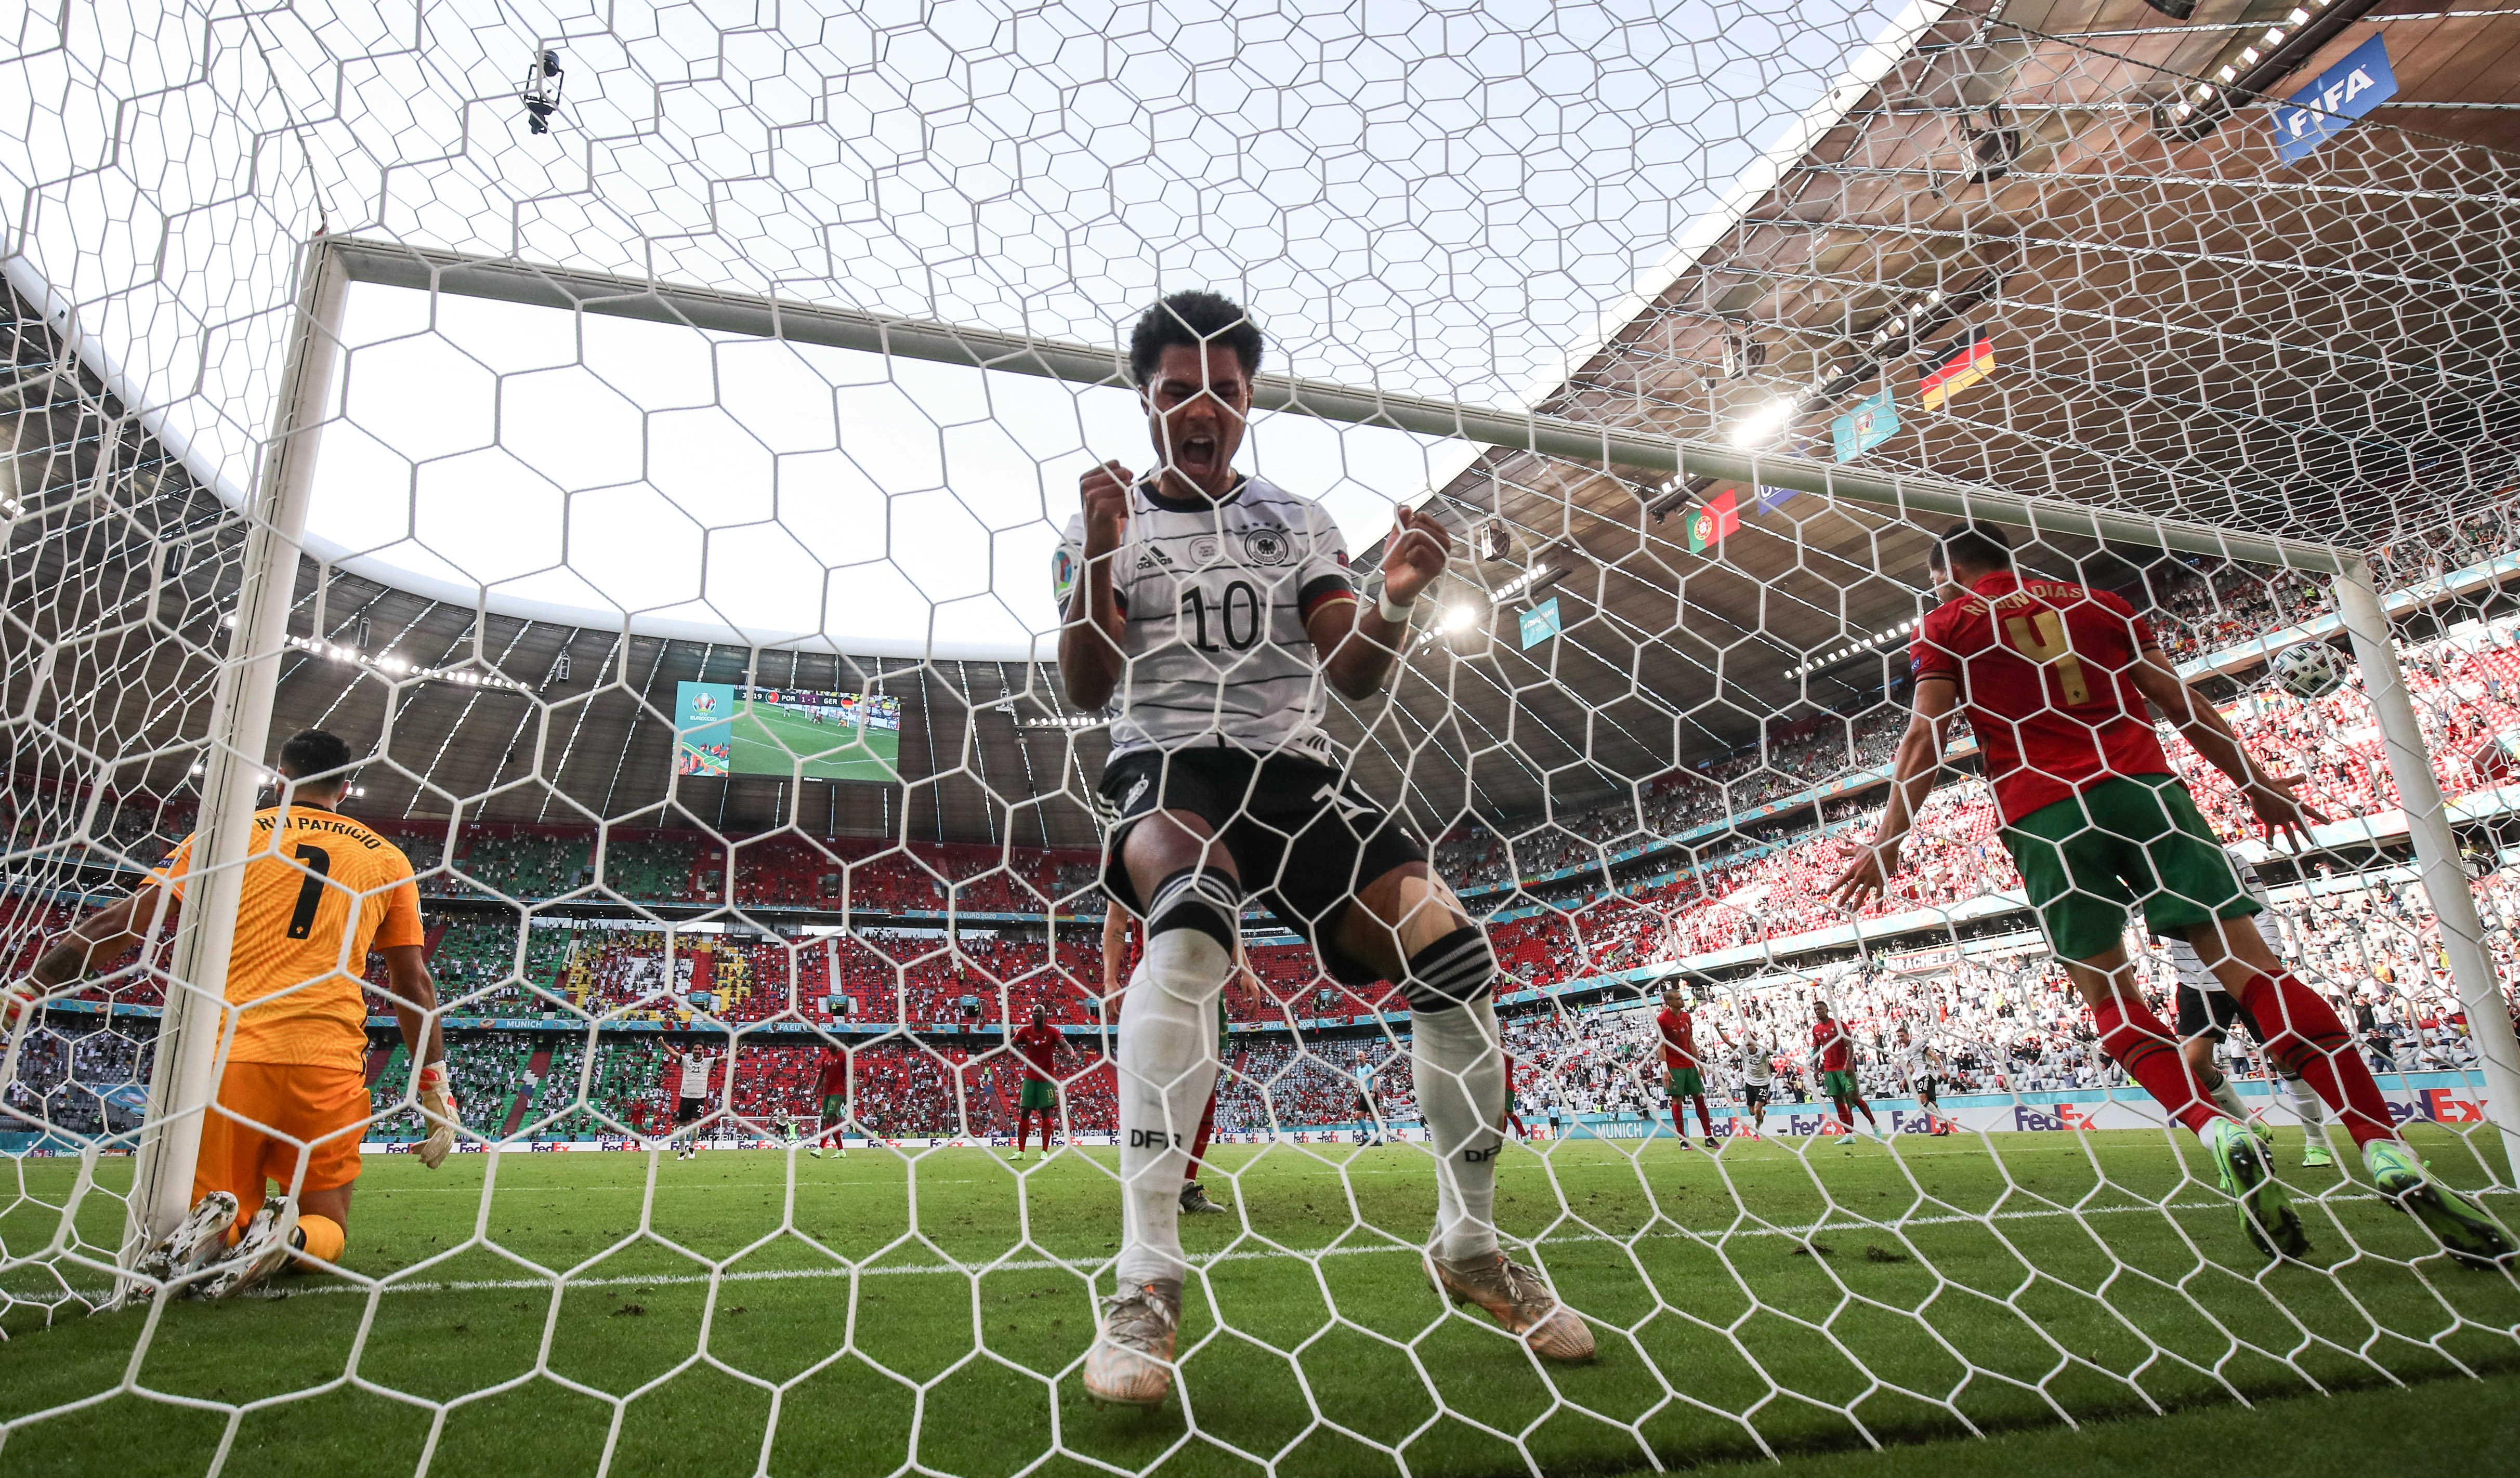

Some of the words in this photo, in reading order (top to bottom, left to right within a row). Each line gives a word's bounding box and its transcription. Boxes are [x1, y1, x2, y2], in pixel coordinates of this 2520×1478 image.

[2288, 68, 2374, 139] FIFA
[2030, 584, 2083, 598] DIAS
[1181, 580, 1260, 653] 10
[2004, 610, 2090, 706] 4
[298, 816, 381, 850] PATRICIO
[1667, 834, 1683, 845] URO
[1683, 830, 1698, 840] 2020
[286, 843, 331, 940] 1
[1758, 1088, 1768, 1097] 25
[2386, 1088, 2489, 1123] edEx
[1791, 1114, 1847, 1136] FedEx
[2015, 1104, 2097, 1131] FedEx
[1294, 1131, 1309, 1143] FedEx
[1322, 1131, 1339, 1142] FedEx
[1596, 1123, 1643, 1138] MUNICH
[460, 1143, 490, 1153] FedE
[531, 1142, 570, 1152] FedEx
[992, 1138, 1019, 1147] FedE
